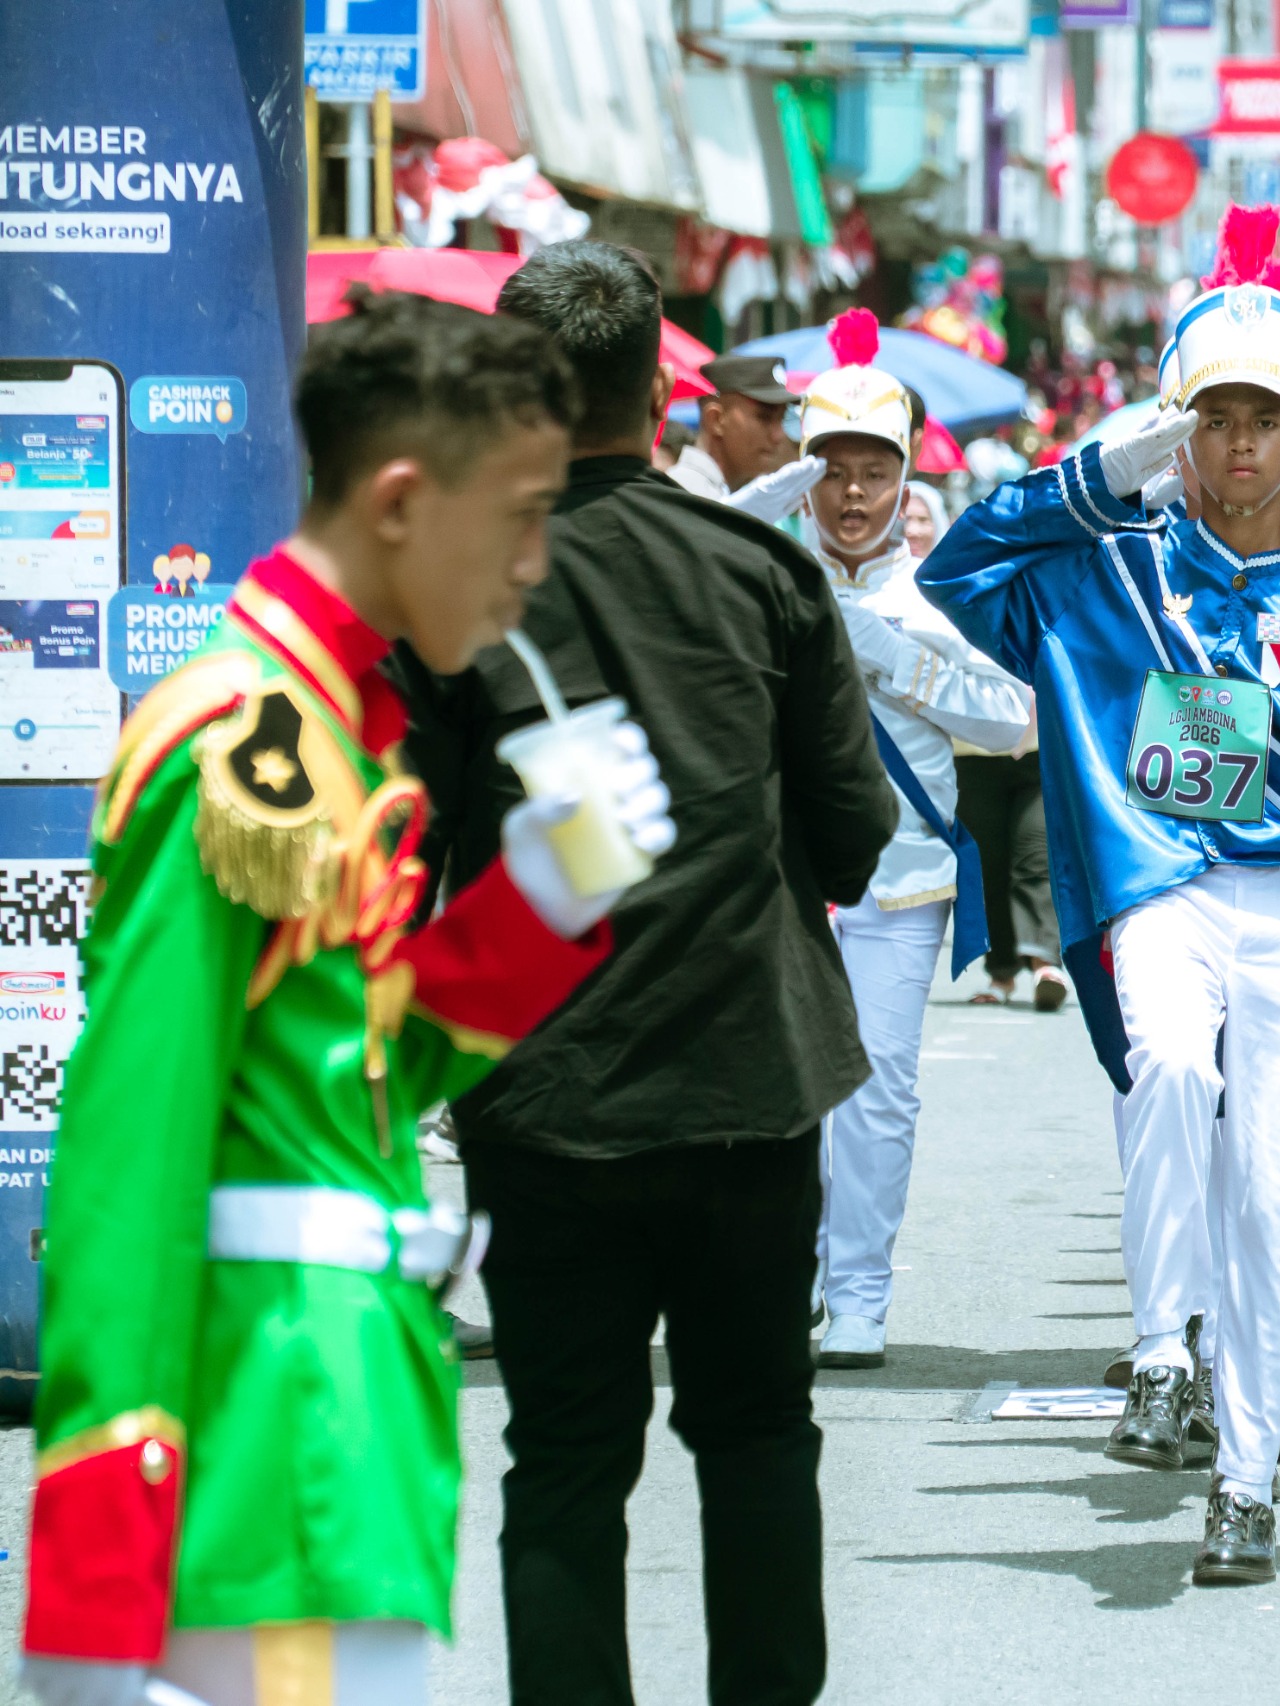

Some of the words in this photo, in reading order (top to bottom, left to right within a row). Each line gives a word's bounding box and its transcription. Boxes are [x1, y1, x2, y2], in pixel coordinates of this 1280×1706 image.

[0, 161, 243, 203] TUNGNYA
[55, 221, 164, 243] sekarang!
[148, 384, 231, 401] CASHBACK
[149, 400, 212, 423] POIN
[51, 625, 84, 635] Promo
[1193, 707, 1237, 733] AMBOINA
[1179, 724, 1221, 746] 2026
[1135, 742, 1260, 810] 037
